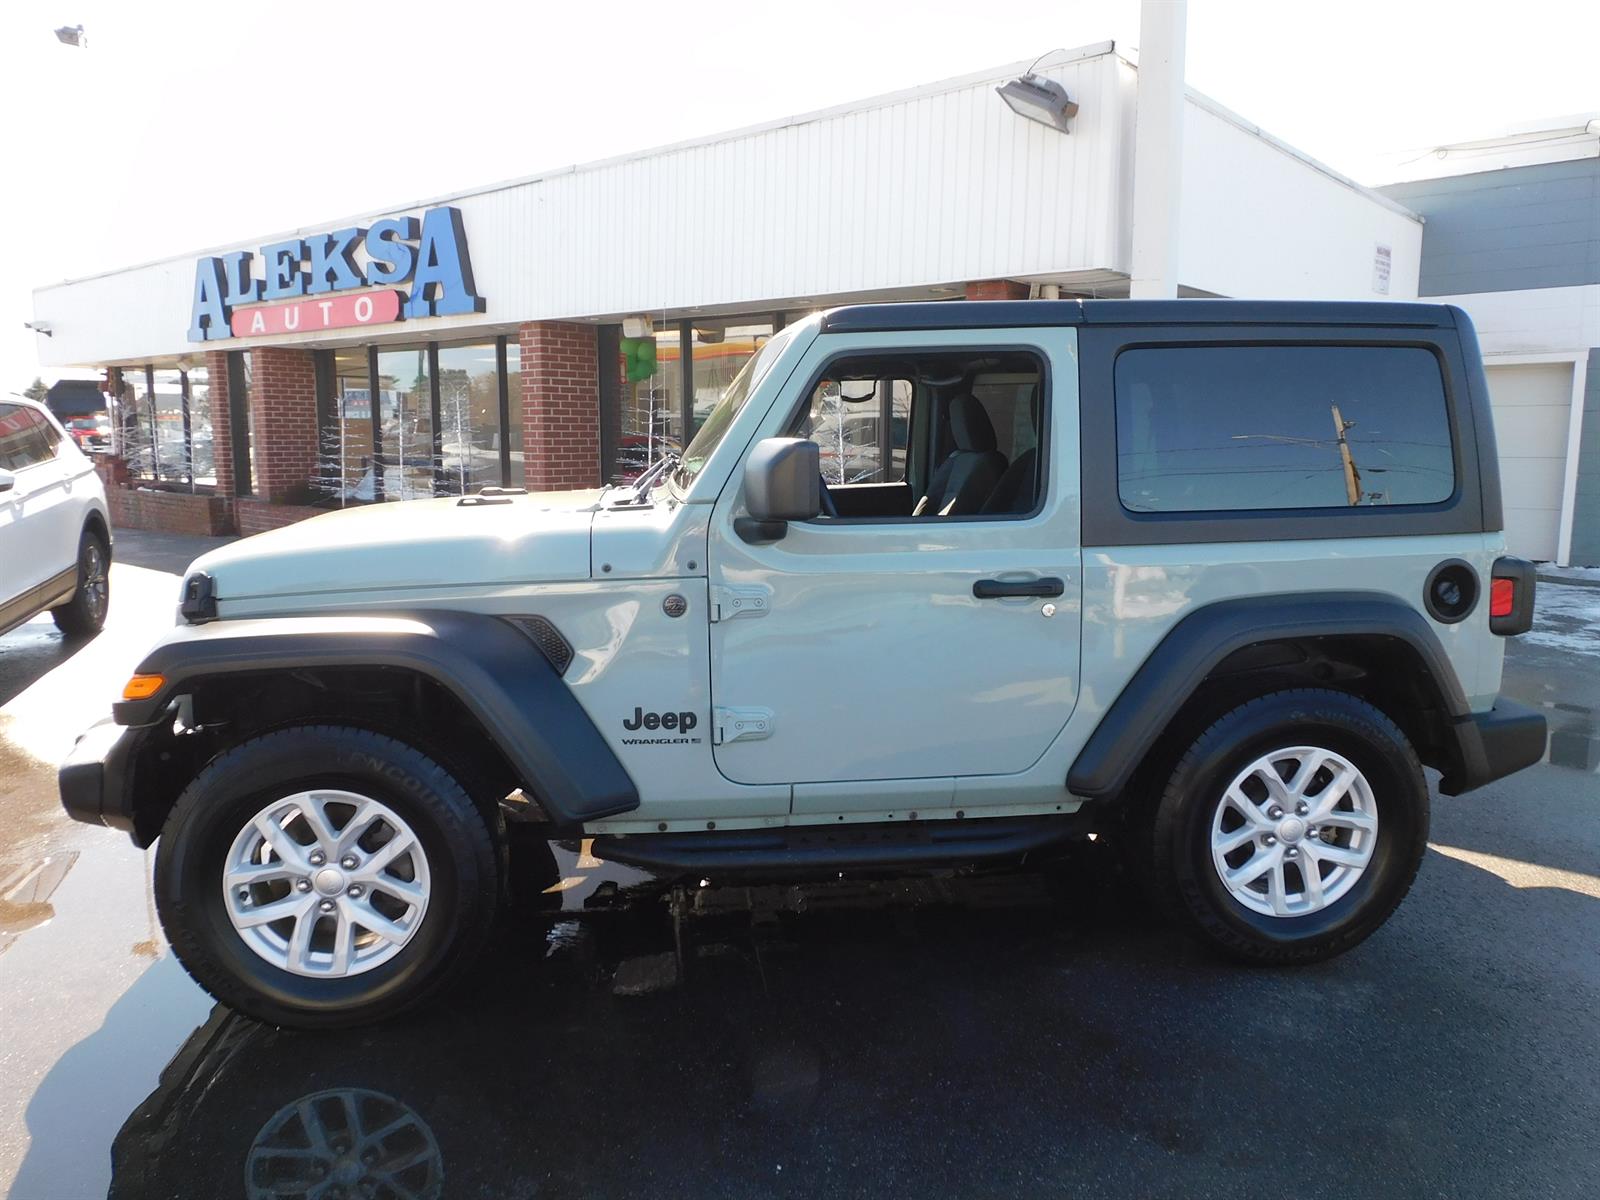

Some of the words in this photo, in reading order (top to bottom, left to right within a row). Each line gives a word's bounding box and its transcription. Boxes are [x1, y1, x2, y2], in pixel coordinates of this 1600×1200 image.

[187, 206, 486, 342] ALEKSA
[251, 296, 373, 333] AUTO
[623, 706, 698, 734] Jeep
[621, 737, 689, 745] WRANGLER
